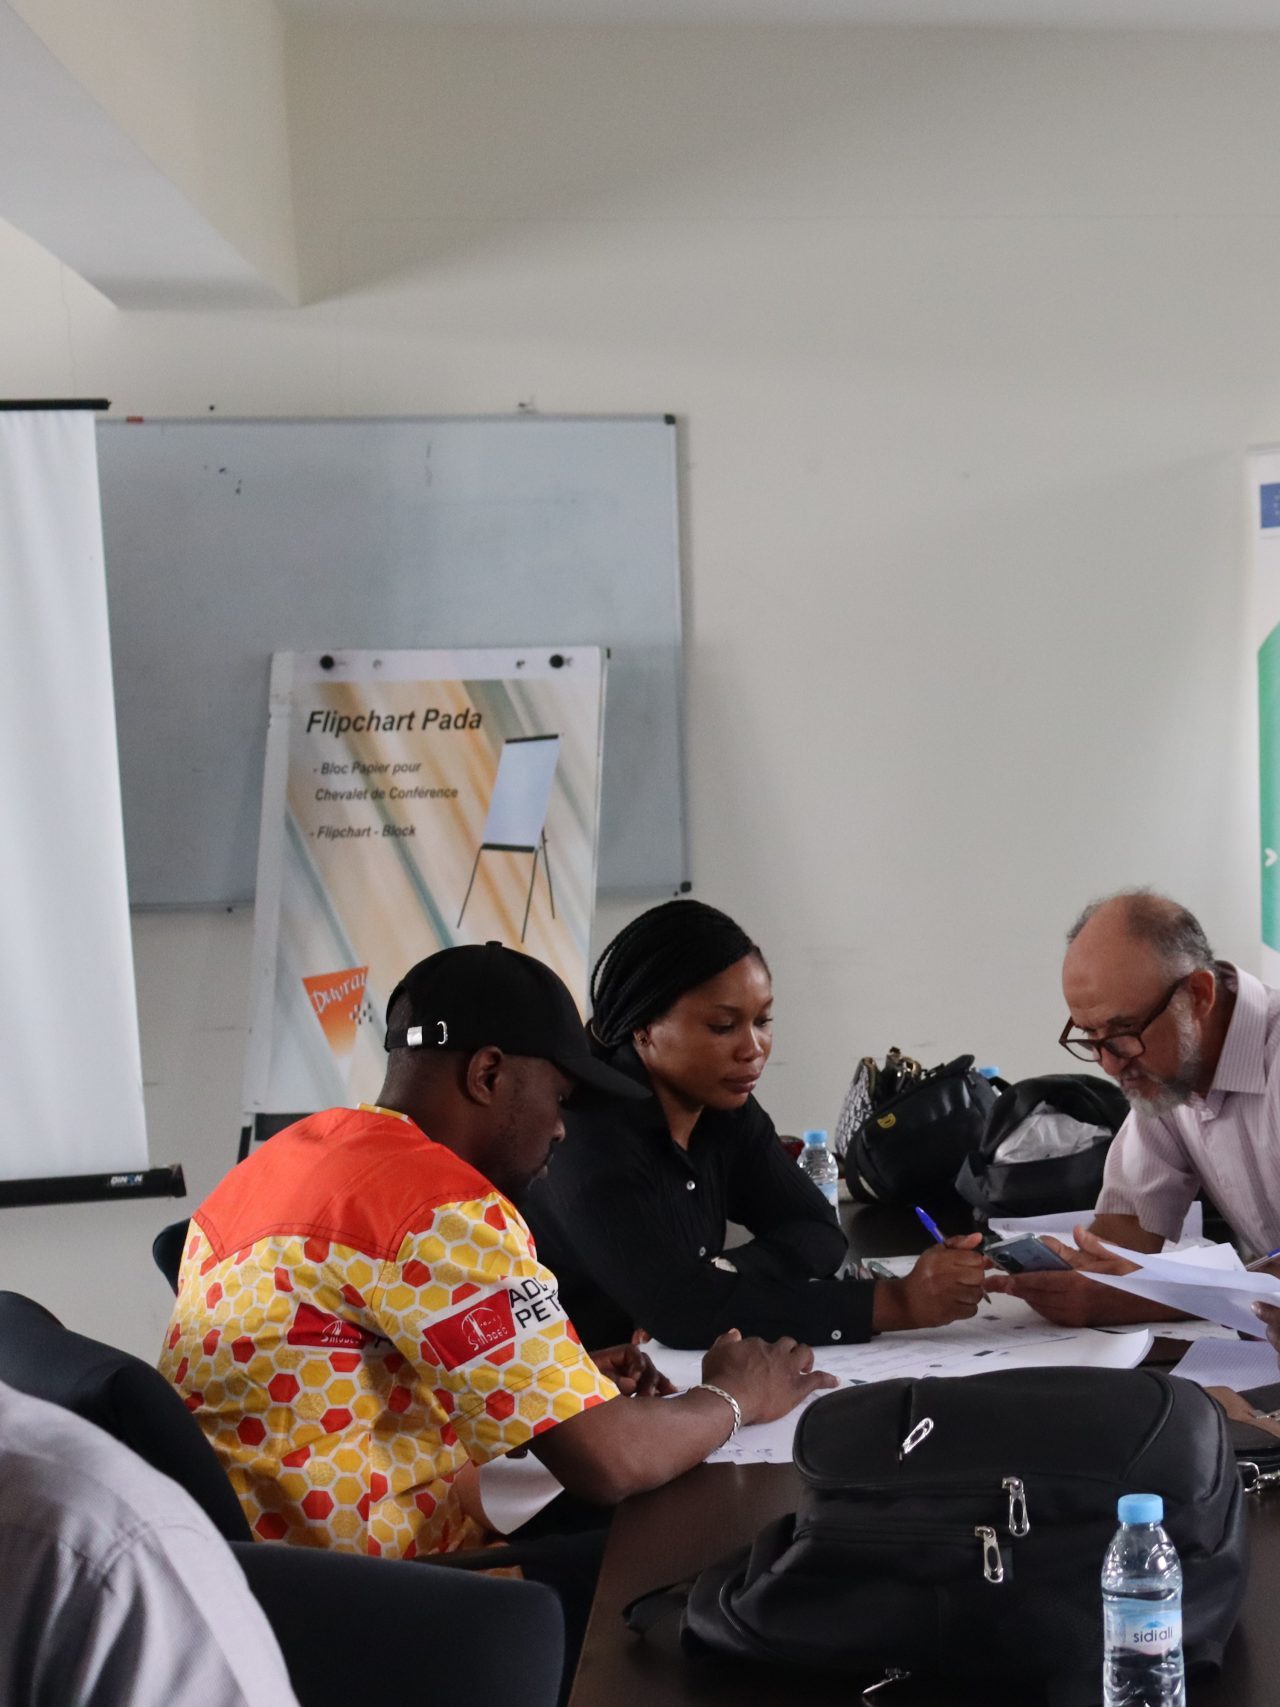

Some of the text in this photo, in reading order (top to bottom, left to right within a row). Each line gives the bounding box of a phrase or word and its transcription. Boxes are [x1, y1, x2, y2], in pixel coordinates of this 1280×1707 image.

[306, 707, 483, 739] Flipchart Pada
[321, 762, 348, 775] Bloc
[351, 762, 390, 776] Papier
[392, 763, 422, 776] pour
[315, 787, 367, 801] Chevalet
[371, 787, 385, 799] de
[317, 826, 371, 840] Flipchart
[382, 824, 416, 837] Block
[1133, 1626, 1173, 1643] sidi ali
